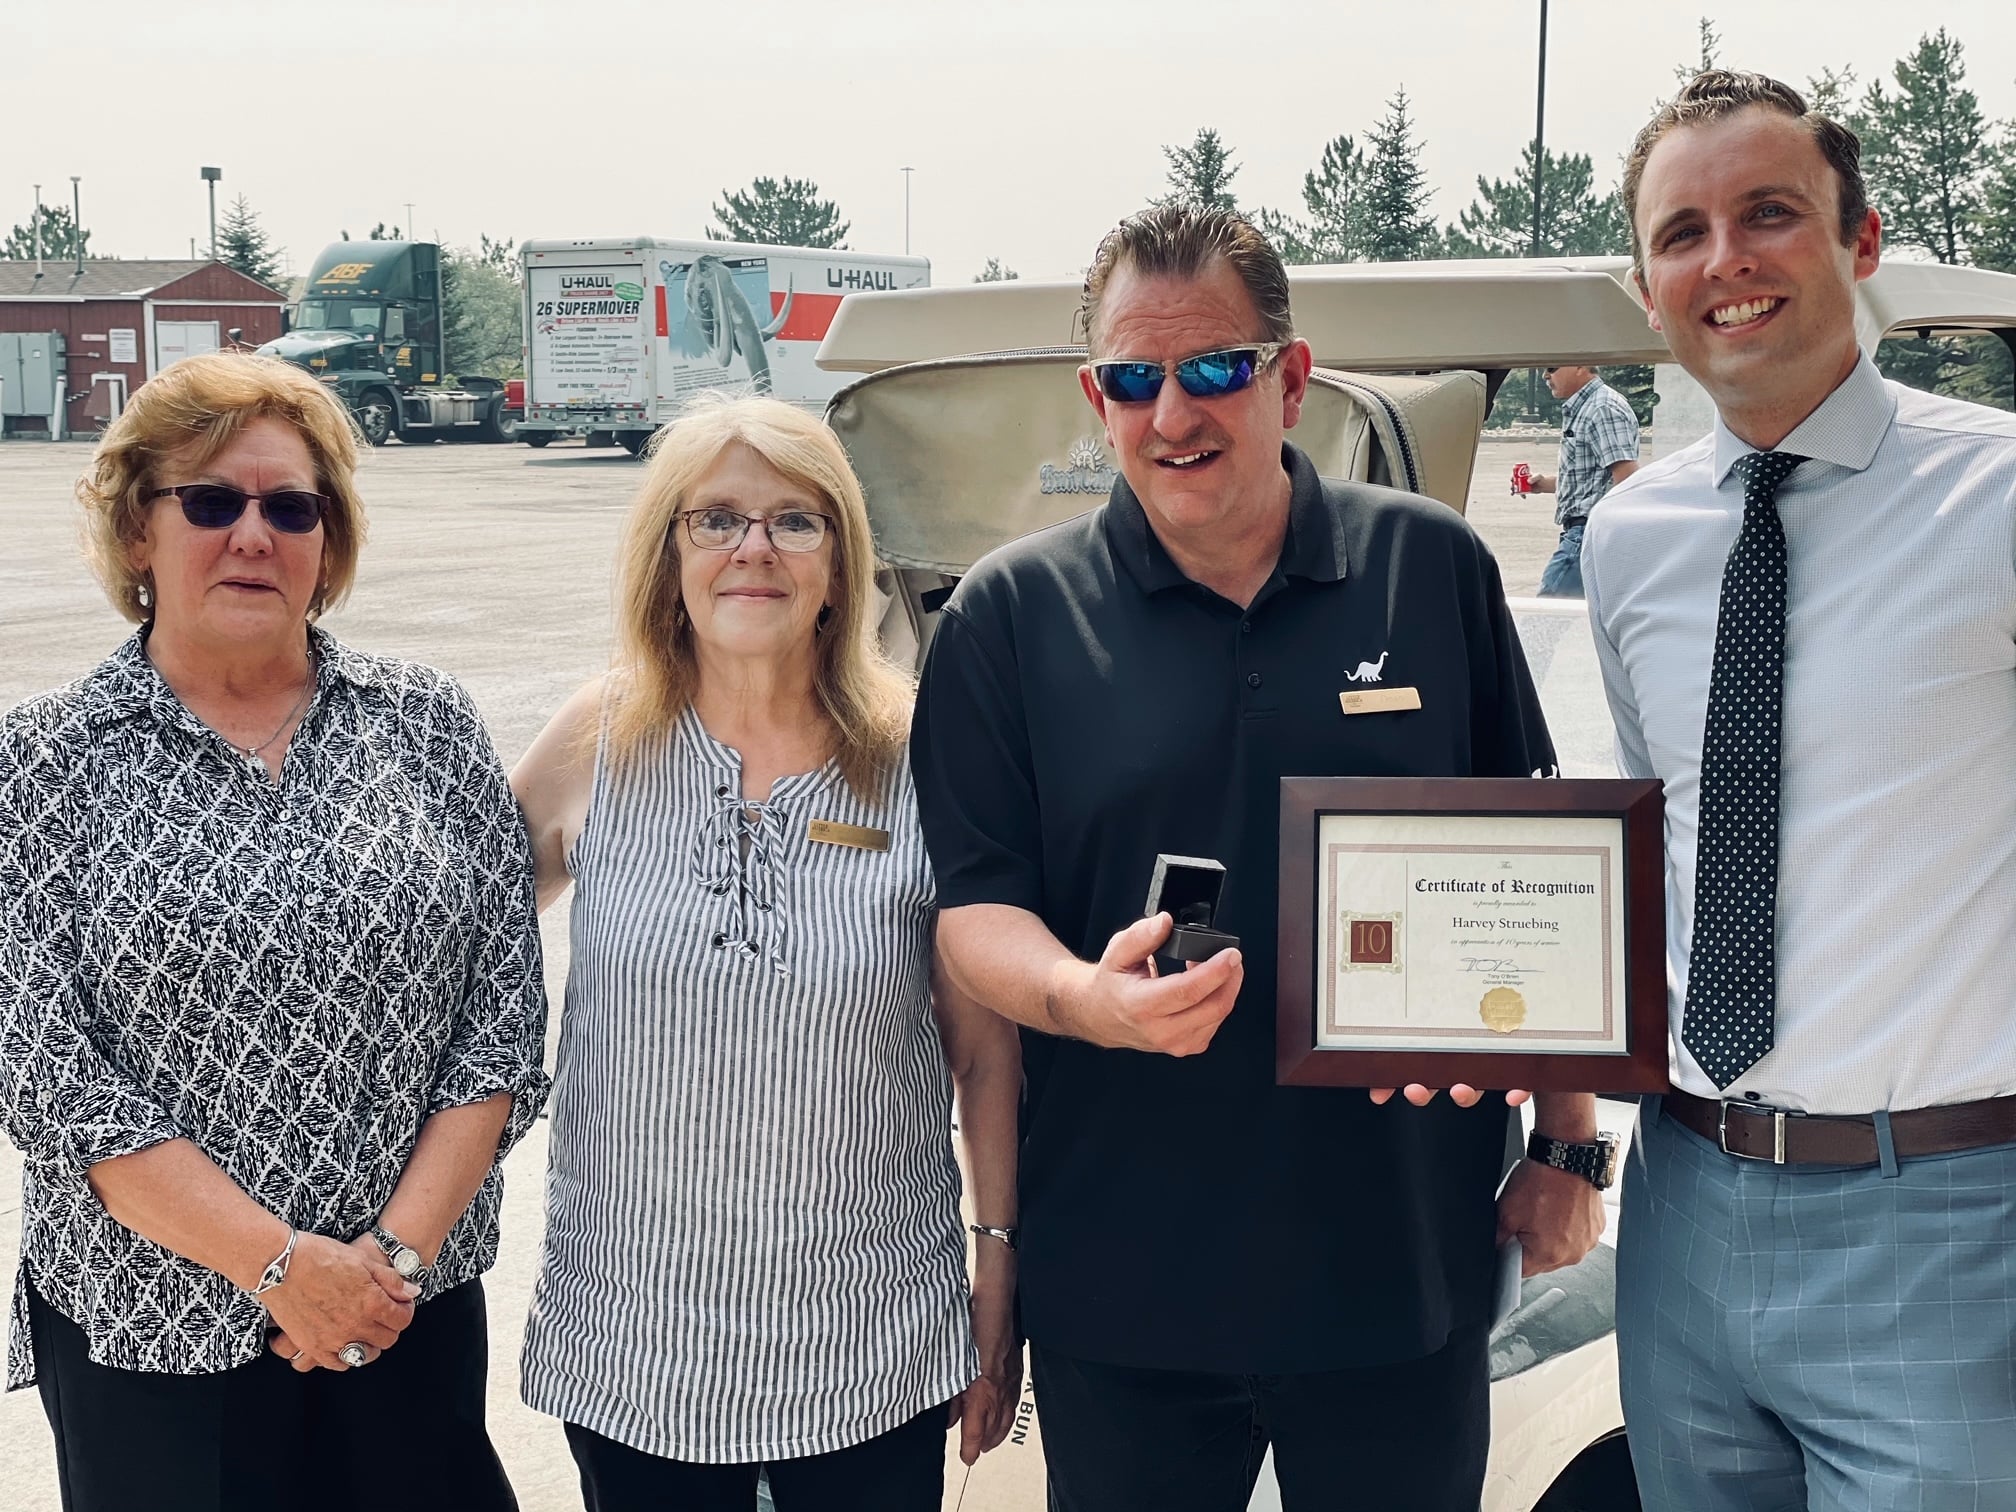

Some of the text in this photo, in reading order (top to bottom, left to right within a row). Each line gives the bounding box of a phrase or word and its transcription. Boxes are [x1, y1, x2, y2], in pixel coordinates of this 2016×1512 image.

[321, 263, 375, 279] ABF
[556, 300, 640, 316] SUPERMOVER
[1415, 878, 1595, 897] Certificate of Recognition
[1452, 917, 1560, 933] Harvey Struebing
[1356, 923, 1386, 954] 10
[1011, 1401, 1035, 1446] BUN
